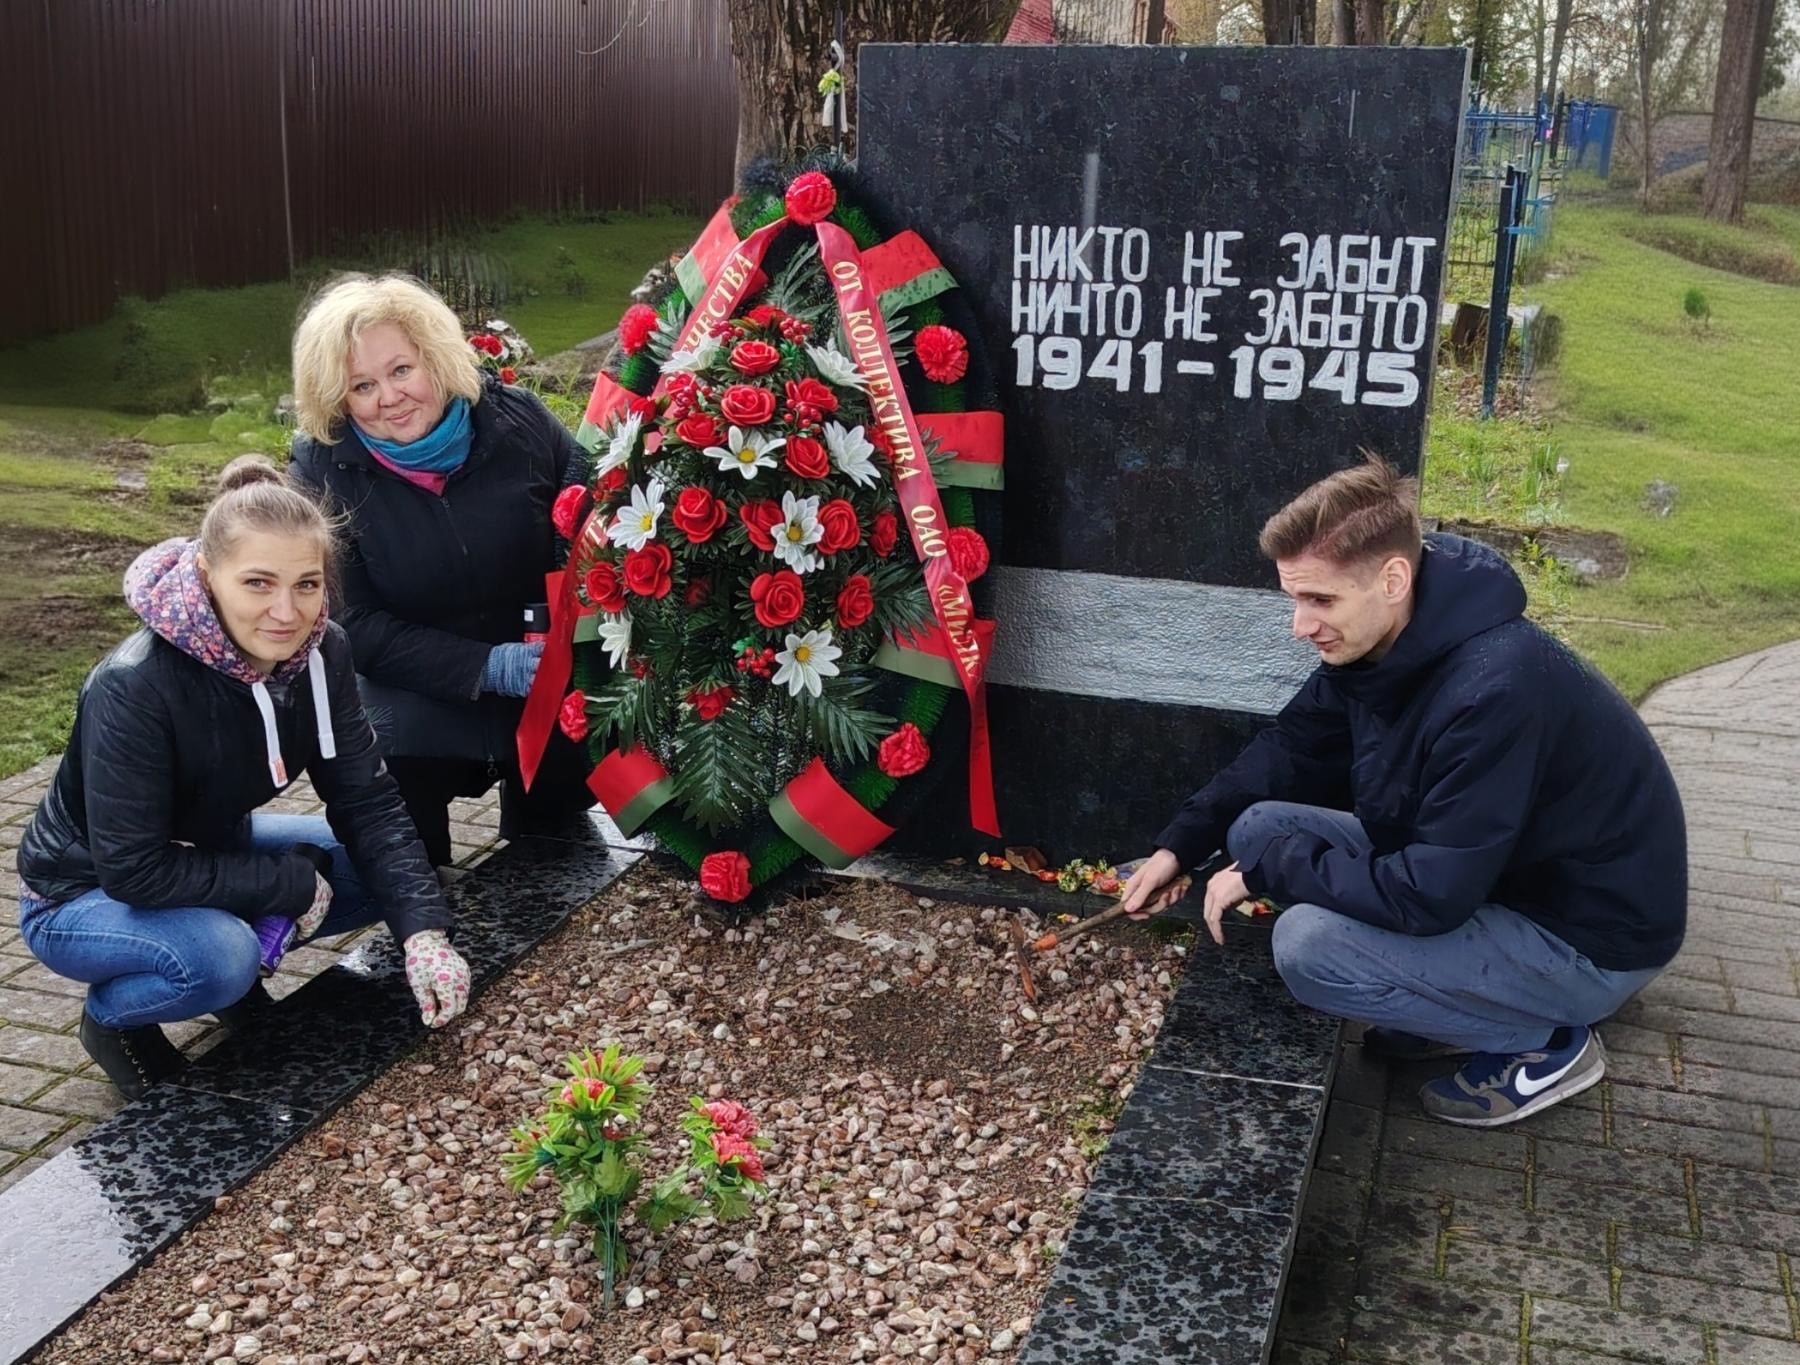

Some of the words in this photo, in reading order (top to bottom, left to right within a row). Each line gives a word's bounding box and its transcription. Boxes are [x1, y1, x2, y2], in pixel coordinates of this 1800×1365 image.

[832, 261, 863, 292] ОТ
[1013, 224, 1149, 283] НИКТО
[1182, 231, 1244, 287] НЕ
[1277, 232, 1436, 293] ЗАБЫТ
[1011, 280, 1142, 337] НИЧТО
[1164, 286, 1222, 341] НЕ
[1244, 289, 1427, 351] ЗАБЫТО
[847, 308, 916, 481] КОЛЛЕКТИВА
[910, 505, 947, 558] ОАО
